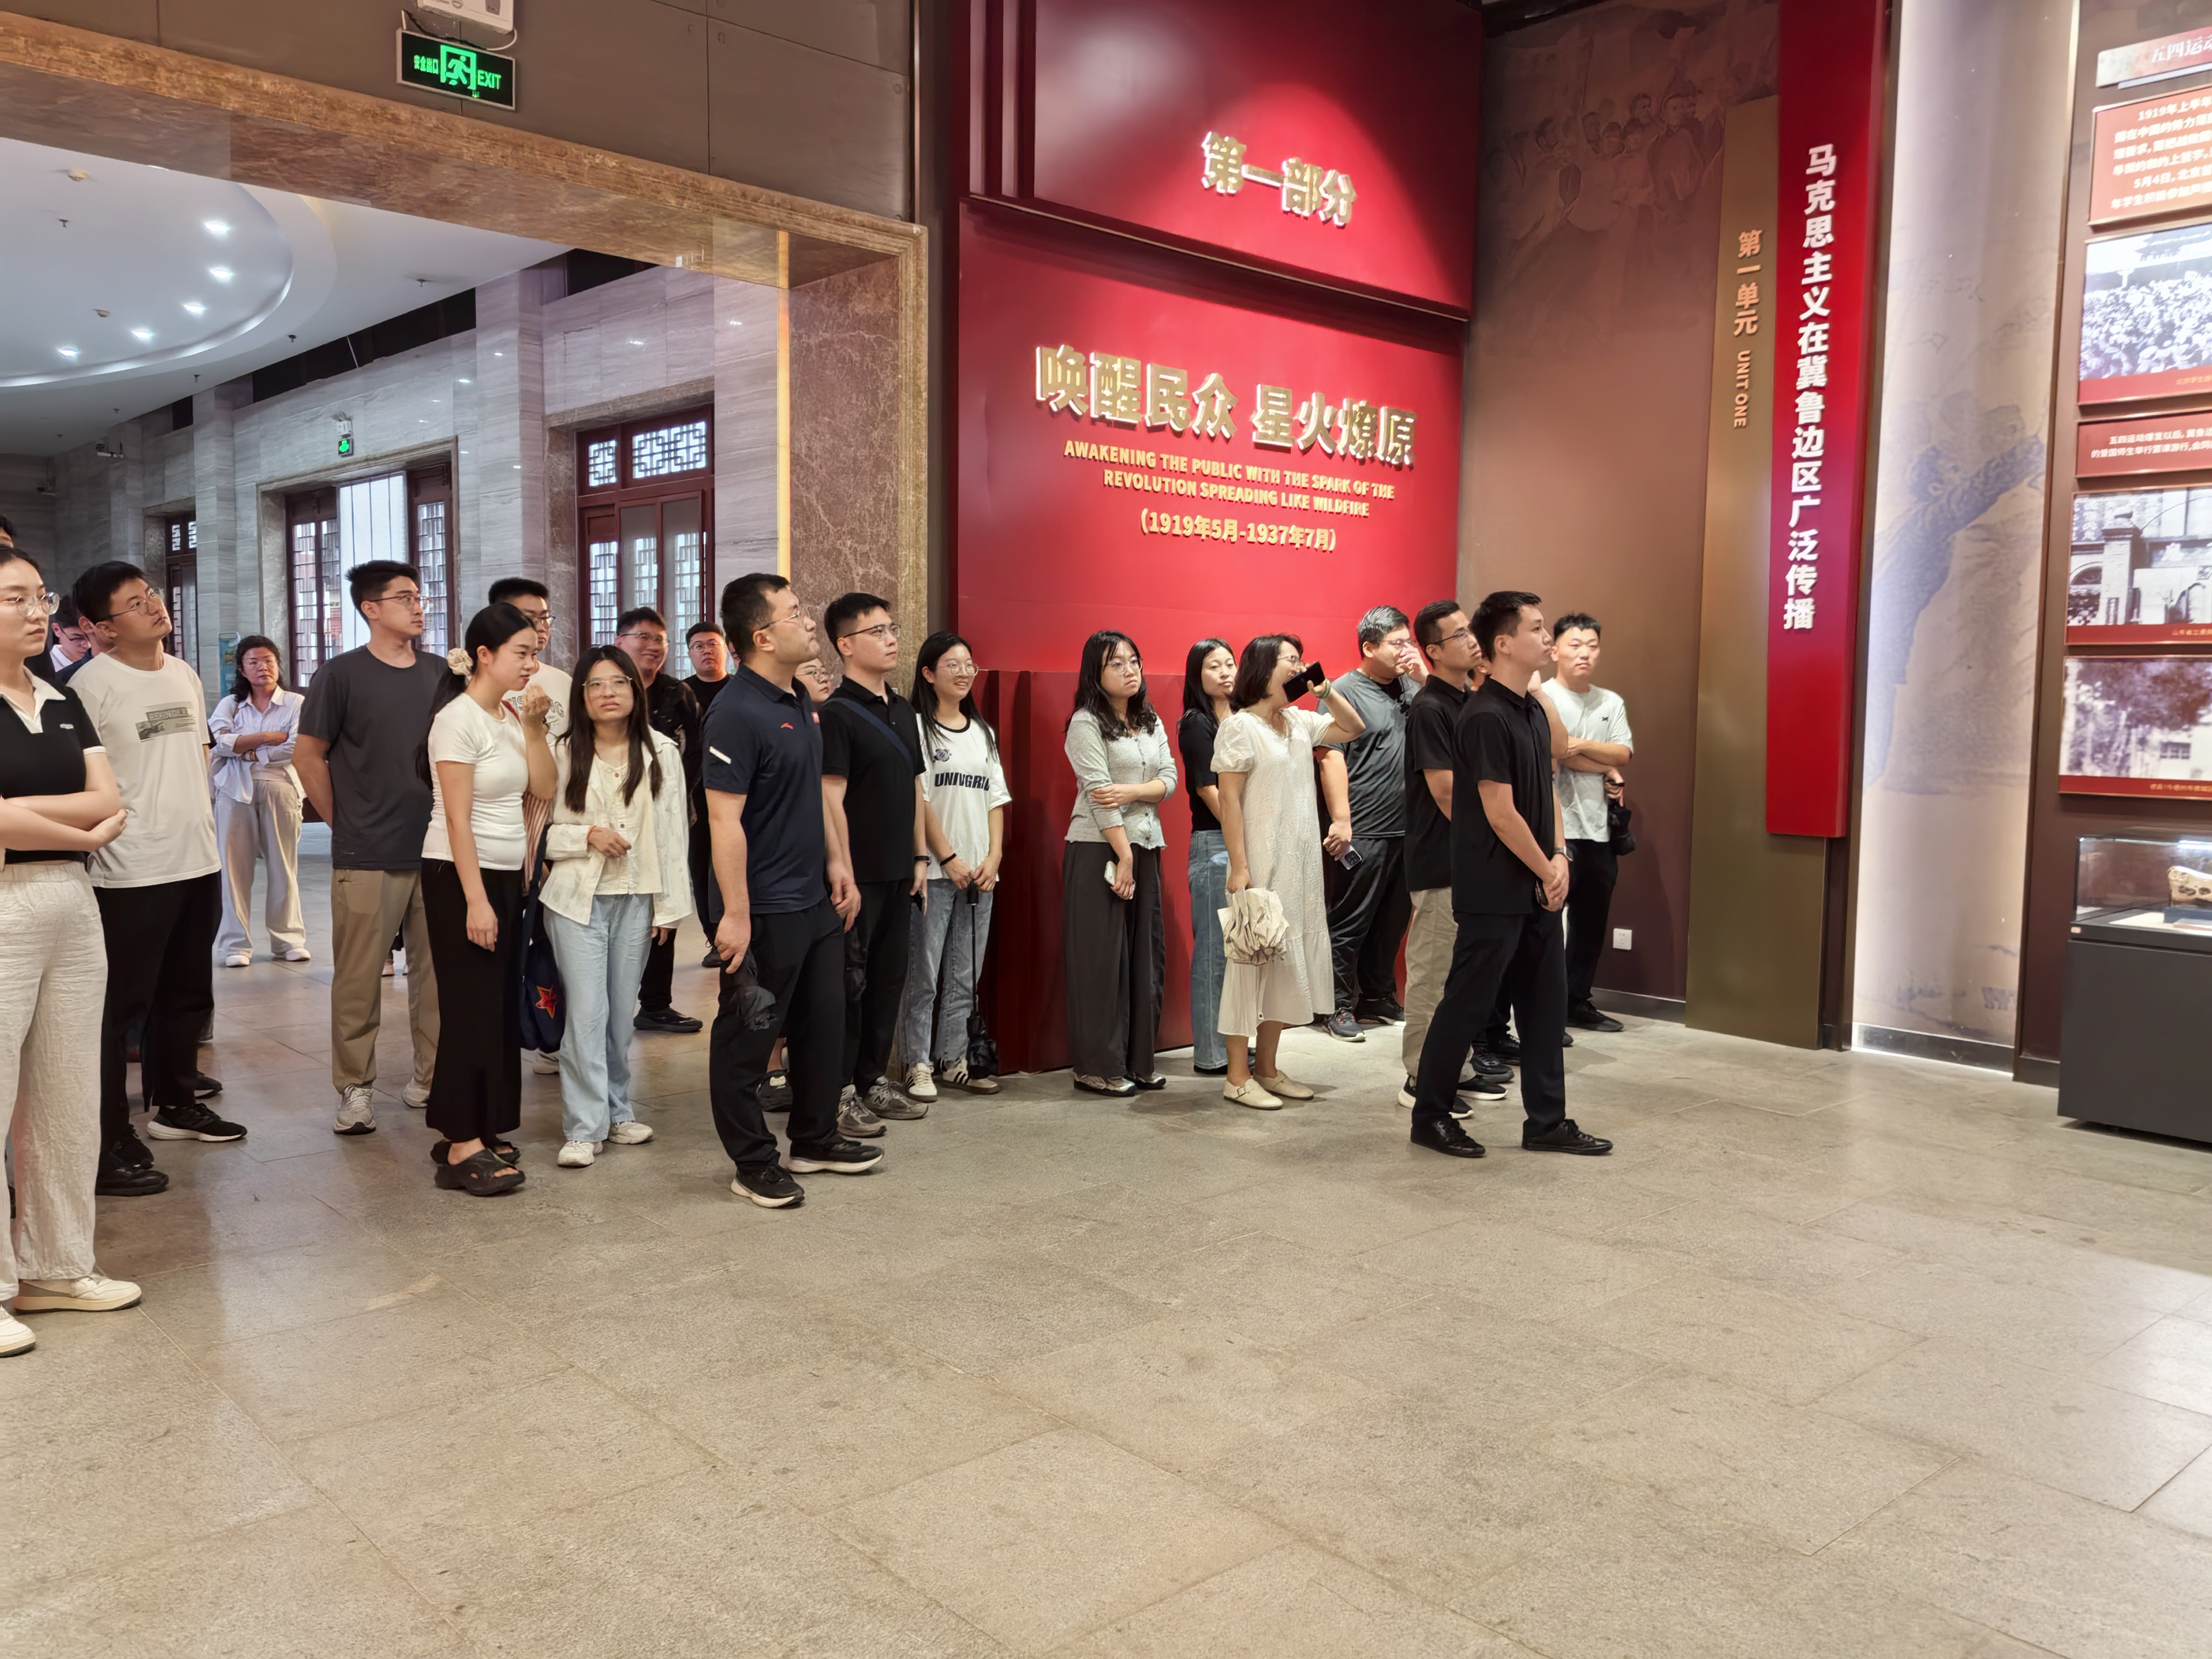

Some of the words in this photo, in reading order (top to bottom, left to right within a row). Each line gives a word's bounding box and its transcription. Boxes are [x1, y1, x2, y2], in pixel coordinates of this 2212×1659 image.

[414, 55, 438, 75] 安全出口
[477, 70, 502, 90] EXIT
[1201, 131, 1358, 227] 第一部分
[1733, 229, 1764, 337] 第一单元
[1736, 350, 1751, 390] UNIT
[1783, 143, 1837, 630] 马克思主义在冀鲁边区广泛传播
[1035, 343, 1238, 440] 唤醒民众
[1252, 383, 1418, 467] 星火燎原
[1734, 392, 1749, 429] ONE
[1063, 440, 1156, 468] AWAKENING
[1160, 454, 1188, 473] THE
[1192, 458, 1242, 480] PUBLIC
[1245, 465, 1280, 484] WITH
[1283, 470, 1310, 488] THE
[1312, 475, 1351, 494] SPARK
[1353, 480, 1370, 496] OF
[1371, 483, 1395, 500] THE
[1104, 469, 1197, 497] REVOLUTION
[1200, 482, 1278, 506] SPREADING
[1281, 492, 1310, 510] LIKE
[1313, 496, 1370, 517] WILDFIRE
[1141, 508, 1337, 552] (1919年5月-1937年7月)
